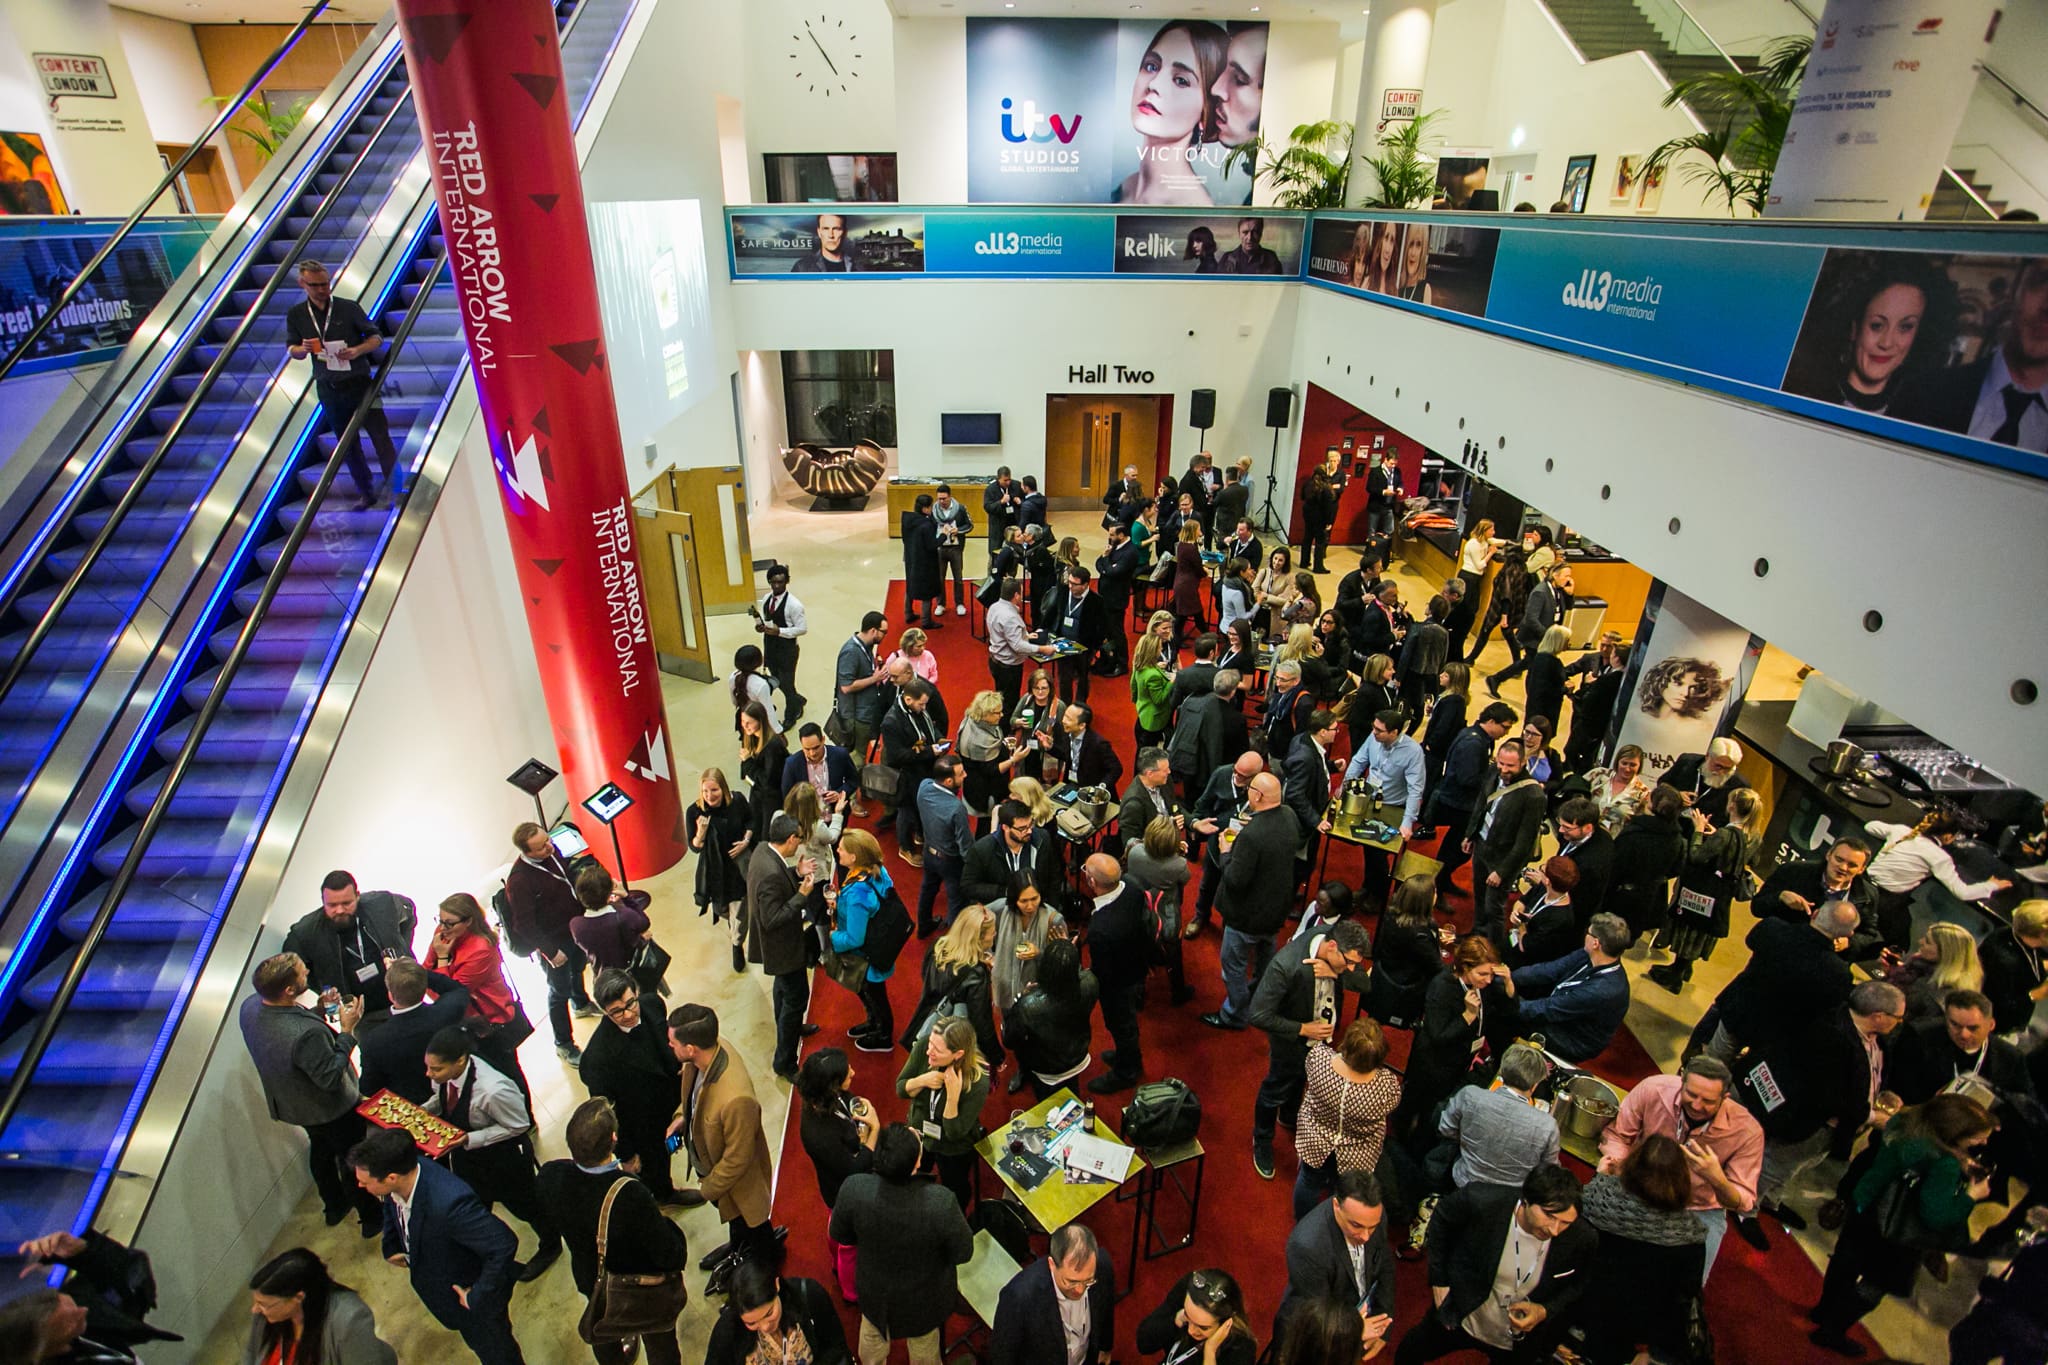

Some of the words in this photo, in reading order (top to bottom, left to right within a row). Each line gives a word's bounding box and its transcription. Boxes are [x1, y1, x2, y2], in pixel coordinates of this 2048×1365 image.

[38, 58, 99, 74] CONTENT
[46, 77, 98, 92] LONDON
[1387, 93, 1420, 103] CONTENT
[1001, 97, 1083, 144] itv
[1386, 106, 1415, 116] LONDON
[454, 120, 486, 195] RED
[1000, 150, 1080, 164] STUDIOS
[741, 240, 768, 248] SAFE
[773, 239, 813, 249] HOUSE
[1020, 247, 1062, 255] international
[1124, 232, 1176, 259] Rellik
[433, 131, 497, 378] INTERNATIONAL
[468, 204, 512, 322] ARROW
[1311, 256, 1349, 275] GIRLFRIENDS
[36, 298, 132, 329] Poductions
[1606, 304, 1656, 321] international
[1068, 364, 1107, 383] Hall
[1113, 365, 1155, 383] Two
[612, 497, 631, 553] RED
[592, 508, 640, 697] INTERNATIONAL
[621, 560, 647, 643] ARROW
[1778, 842, 1806, 862] ST
[1682, 889, 1712, 905] CONTENT
[1752, 1070, 1770, 1104] LONDON
[1757, 1065, 1782, 1102] CONTENT
